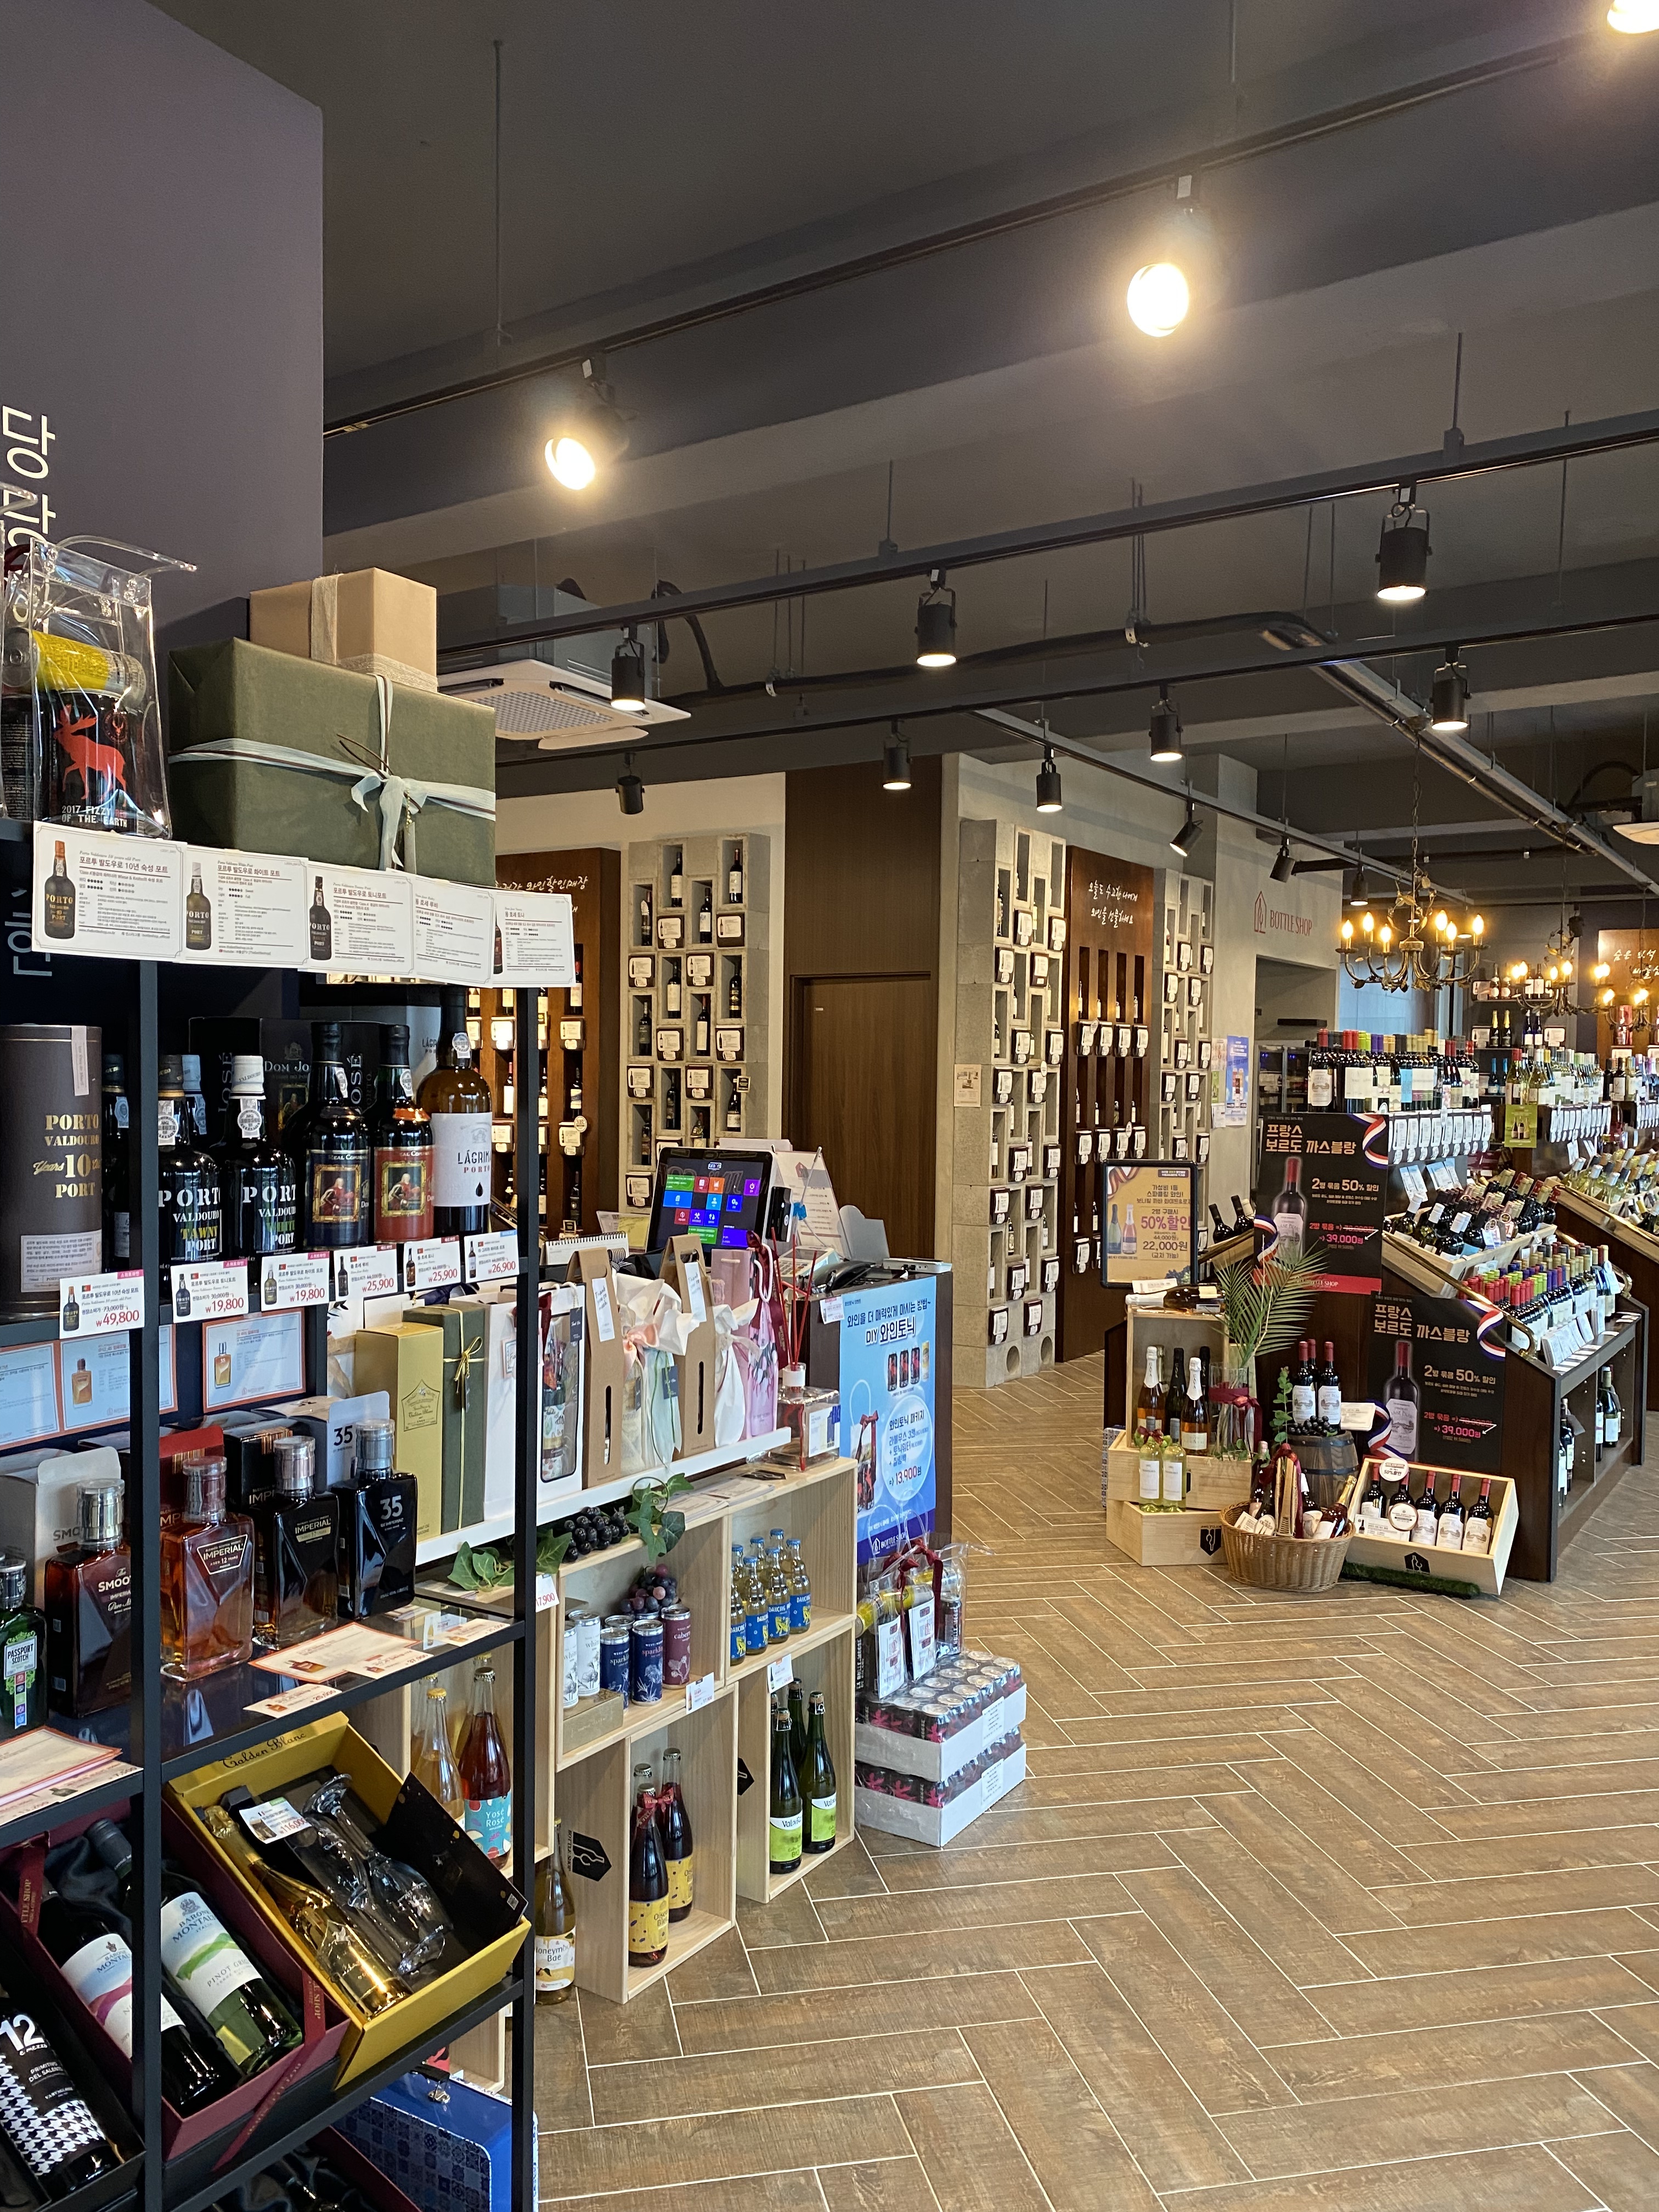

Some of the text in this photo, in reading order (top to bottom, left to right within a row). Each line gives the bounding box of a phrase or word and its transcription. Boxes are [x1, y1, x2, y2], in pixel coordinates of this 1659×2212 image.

[61, 804, 111, 816] 2017 FIZZY
[61, 814, 128, 828] OF THE EARTH
[125, 862, 139, 871] 10년
[141, 864, 154, 872] 숙성
[1088, 879, 1103, 900] 오늘도
[1105, 884, 1122, 900] 수고한
[46, 893, 73, 905] PORTO
[1091, 906, 1133, 928] 와인을 선물하세요
[1269, 909, 1313, 936] BOTTLE SHOP
[264, 1061, 294, 1072] DOM
[45, 1113, 99, 1130] PORTO
[1266, 1124, 1303, 1138] 프랑스
[44, 1134, 100, 1147] VALDOURO
[1266, 1138, 1356, 1155] 보르도 까스블랑
[33, 1153, 92, 1179] Years 10
[463, 1165, 490, 1174] PORTO
[55, 1182, 95, 1199] PORT
[1312, 1178, 1326, 1190] 2병
[1341, 1179, 1365, 1192] 50%
[180, 1225, 218, 1240] TAWNY
[272, 1231, 295, 1245] PORT
[185, 1238, 216, 1252] PORT
[1142, 1241, 1188, 1252] 22,000원
[848, 1312, 866, 1328] 와인을
[868, 1310, 874, 1323] 더
[875, 1305, 898, 1321] 매력있게
[900, 1301, 916, 1316] 마시는
[1374, 1304, 1413, 1321] 프랑스
[866, 1316, 916, 1344] DIY 와인토닉
[1374, 1319, 1471, 1344] 보르도 까스블랑
[1424, 1364, 1439, 1378] 2병
[1455, 1369, 1481, 1383] 50%
[1482, 1376, 1497, 1385] 할인
[889, 1409, 925, 1431] 와인토닉 패키지
[333, 1425, 353, 1447] 35
[380, 1494, 403, 1520] 35
[295, 1517, 331, 1534] IMPERIAL
[881, 1535, 895, 1549] BOTTLE
[203, 1543, 244, 1561] IMPERIAL
[98, 1575, 132, 1593] SMOO
[109, 1590, 132, 1600] IMPERIA
[7, 1643, 34, 1660] PASSPORT
[12, 1654, 29, 1664] SCOTCH
[267, 1733, 307, 1750] Blanc
[486, 1809, 505, 1819] Yosé
[486, 1816, 505, 1827] Rosé
[178, 1909, 211, 1928] BARONE
[547, 1954, 562, 1962] Bae
[206, 1965, 231, 1988] PINOT
[0, 2014, 45, 2052] 12
[26, 2044, 48, 2053] mezzo
[28, 2072, 42, 2083] DEL
